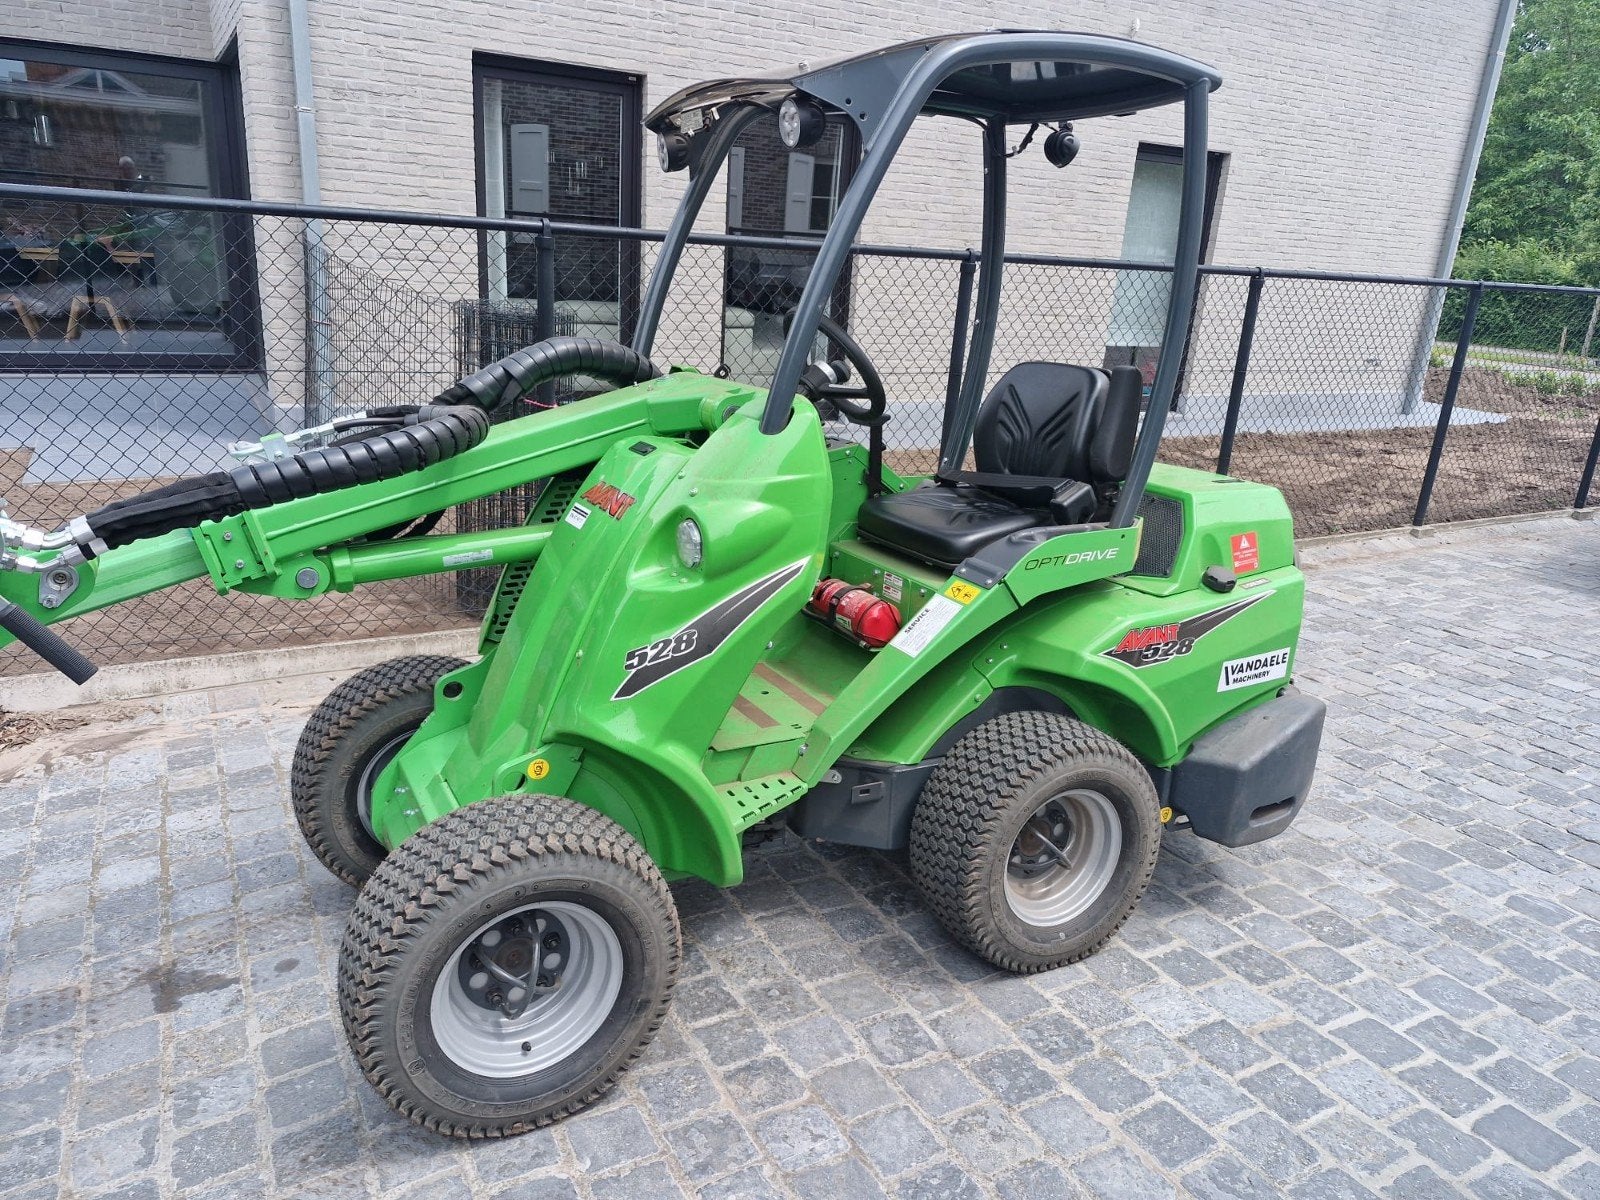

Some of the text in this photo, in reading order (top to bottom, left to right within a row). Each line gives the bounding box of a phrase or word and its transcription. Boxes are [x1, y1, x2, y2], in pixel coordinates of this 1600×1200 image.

[580, 480, 636, 520] AVANT
[1025, 548, 1119, 570] OPTIDRIVE
[904, 608, 930, 634] SERVICE
[624, 629, 698, 671] 528
[1114, 623, 1180, 654] AVANT
[1141, 638, 1195, 661] 528
[1230, 652, 1288, 676] VANDAELE
[1232, 670, 1271, 685] MACHINERY
